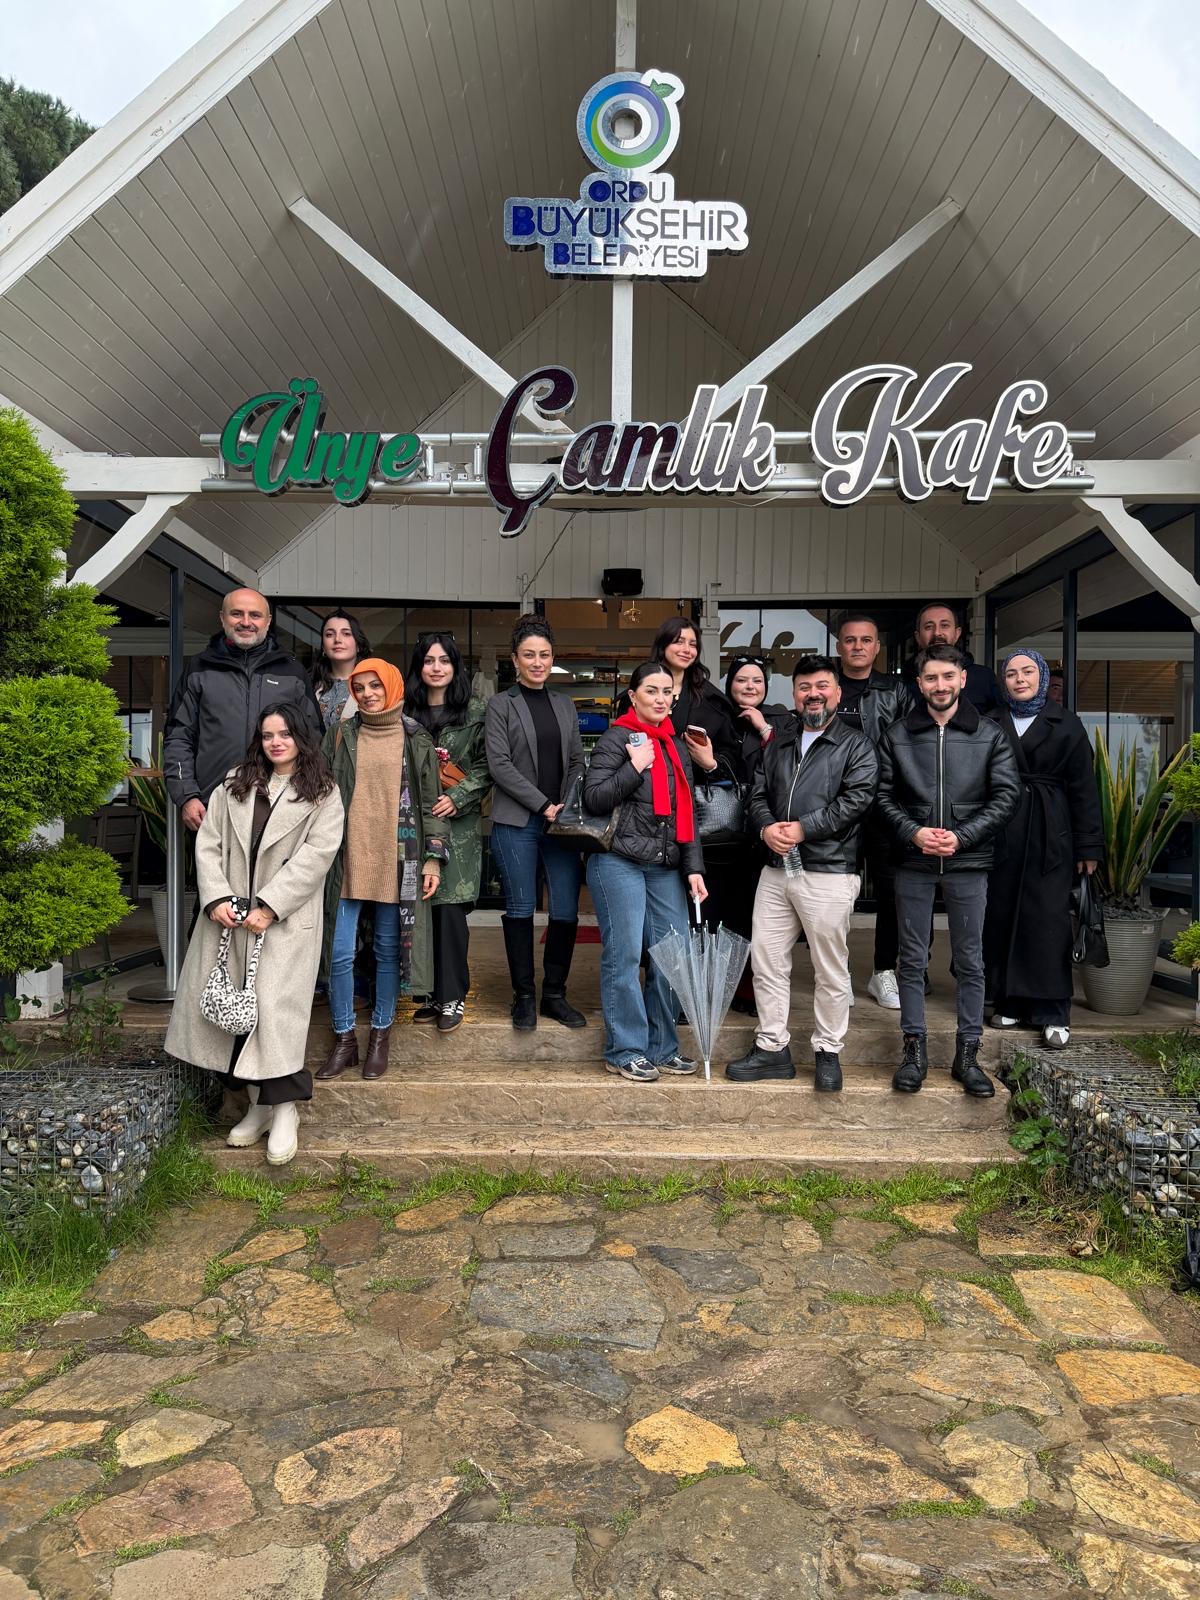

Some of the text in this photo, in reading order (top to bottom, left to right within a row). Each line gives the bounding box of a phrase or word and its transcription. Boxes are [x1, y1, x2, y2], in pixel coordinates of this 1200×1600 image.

[588, 180, 666, 203] ORDU
[512, 205, 740, 242] BÜYÜKŞEHİR
[219, 361, 1071, 537] Ünye Çamlık Kafe
